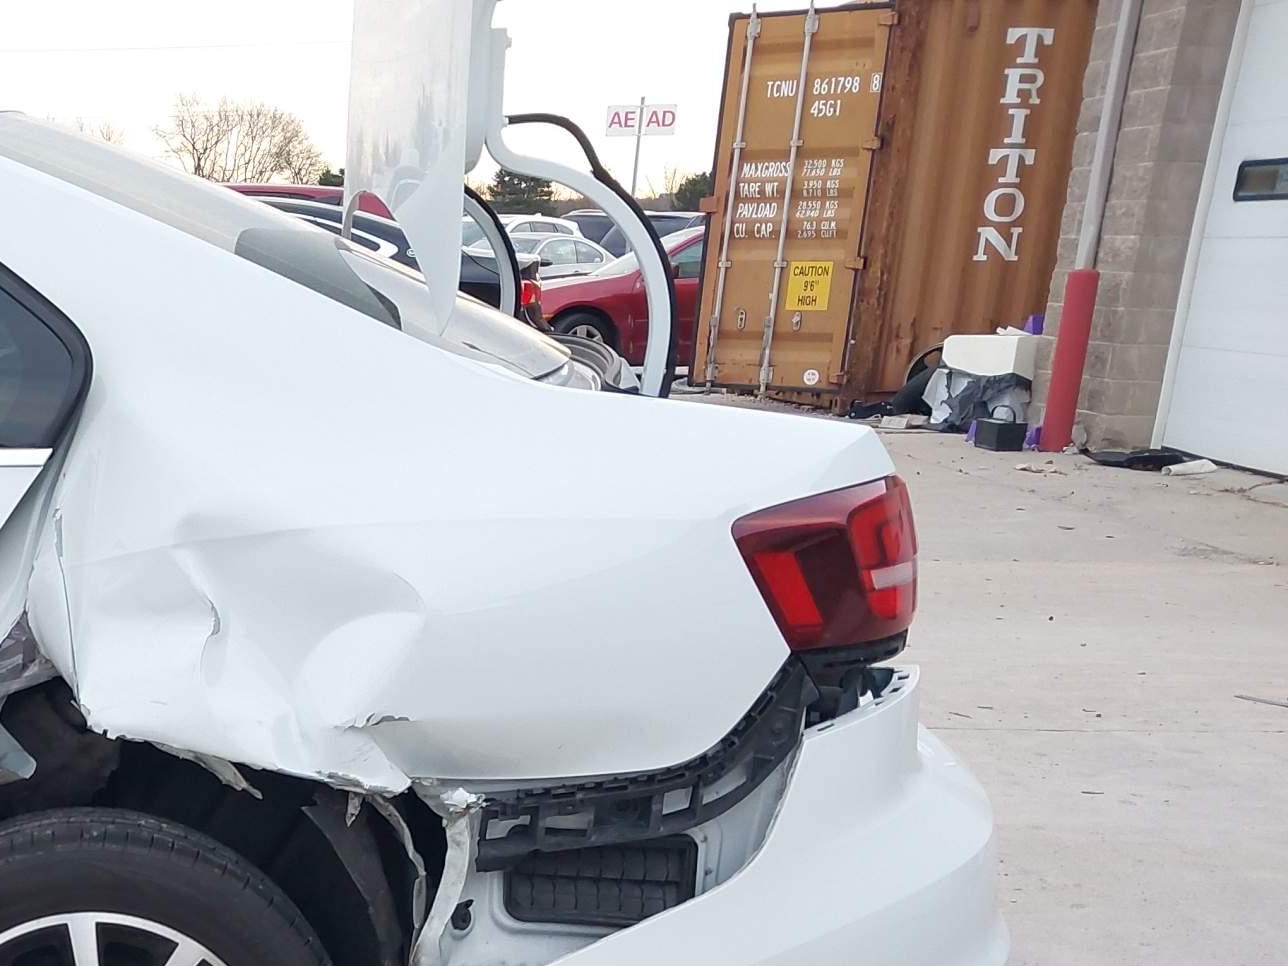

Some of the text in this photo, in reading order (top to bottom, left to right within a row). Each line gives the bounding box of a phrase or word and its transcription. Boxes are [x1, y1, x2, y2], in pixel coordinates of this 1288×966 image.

[767, 80, 797, 98] TCNU
[813, 76, 860, 95] 861798
[810, 100, 841, 117] 45G1
[608, 111, 636, 128] AE
[646, 110, 676, 127] AD
[972, 27, 1055, 261] TRITON
[739, 182, 780, 198] TARE WT.
[736, 202, 778, 218] PAYLOAD
[734, 223, 775, 238] CU. CAP.
[793, 266, 829, 276] CAUTION
[797, 296, 817, 306] HIGH
